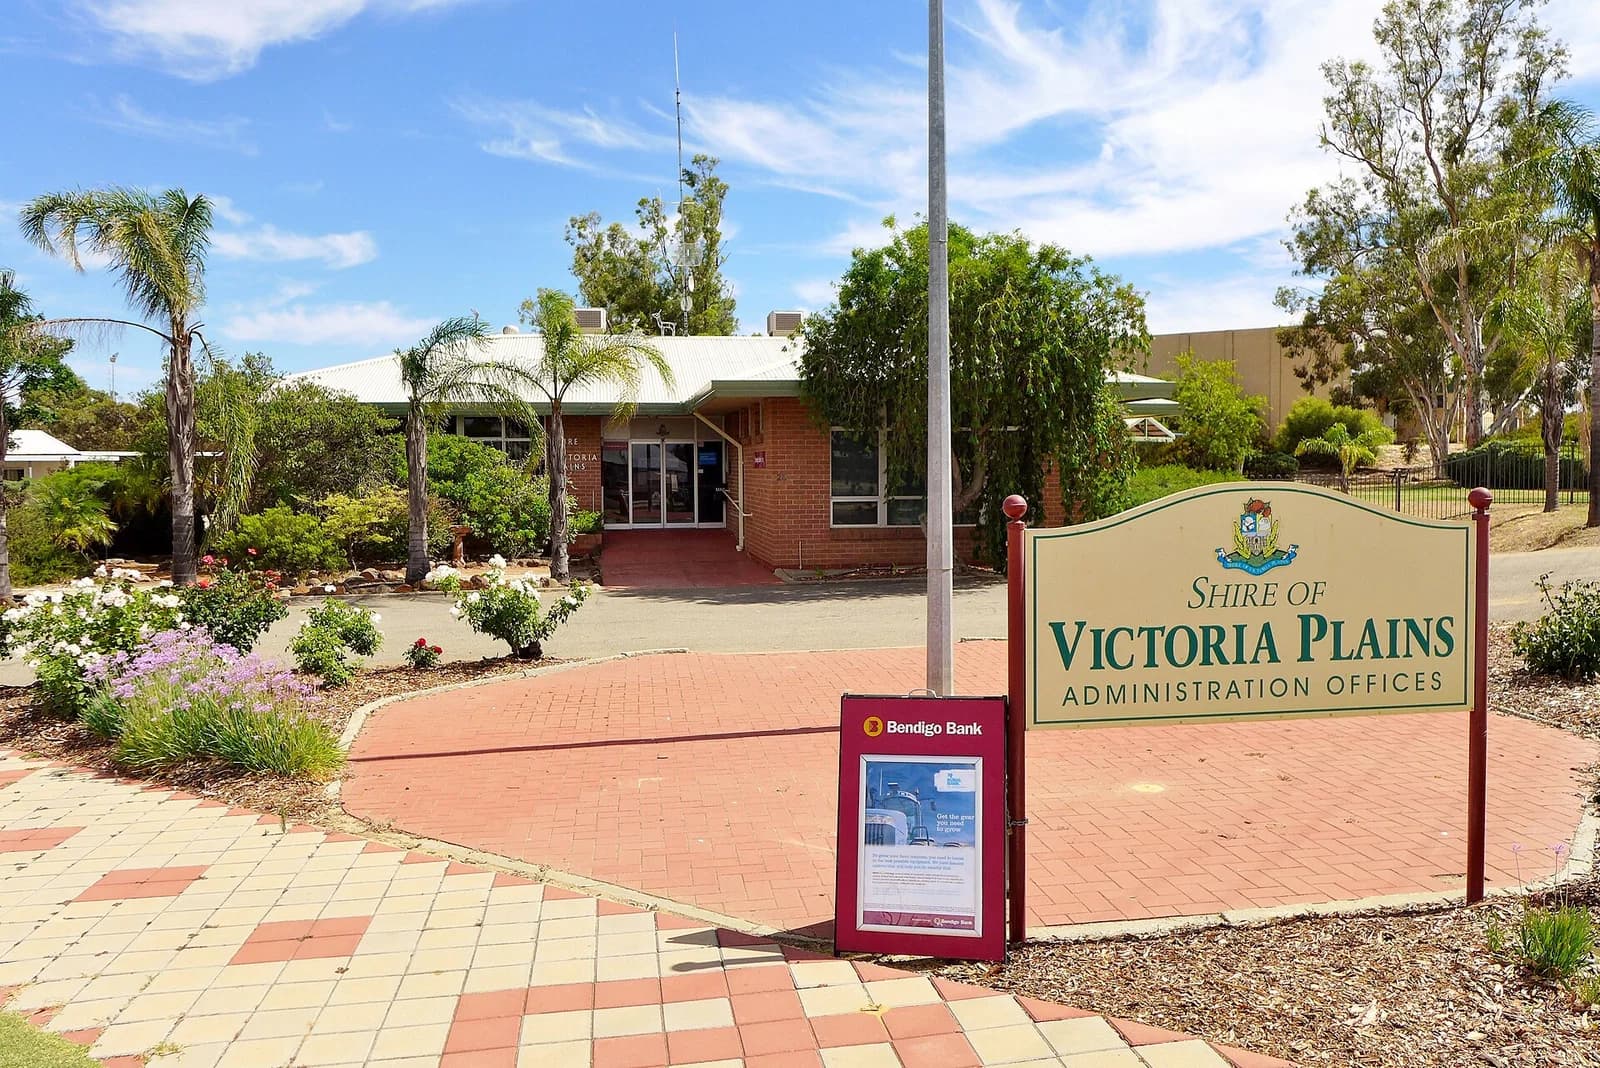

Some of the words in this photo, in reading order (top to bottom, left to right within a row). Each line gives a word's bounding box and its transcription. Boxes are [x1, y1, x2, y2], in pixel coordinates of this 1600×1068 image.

[564, 463, 586, 471] AINS
[568, 453, 597, 461] TORIA
[1188, 576, 1278, 609] SHIRE
[1287, 581, 1327, 606] OF
[1049, 620, 1281, 671] VICTORIA
[1297, 613, 1455, 663] PLAINS
[1062, 676, 1309, 707] ADMINISTRATION
[1326, 671, 1442, 696] OFFICES
[887, 720, 942, 737] Bendigo
[946, 721, 982, 735] Bank
